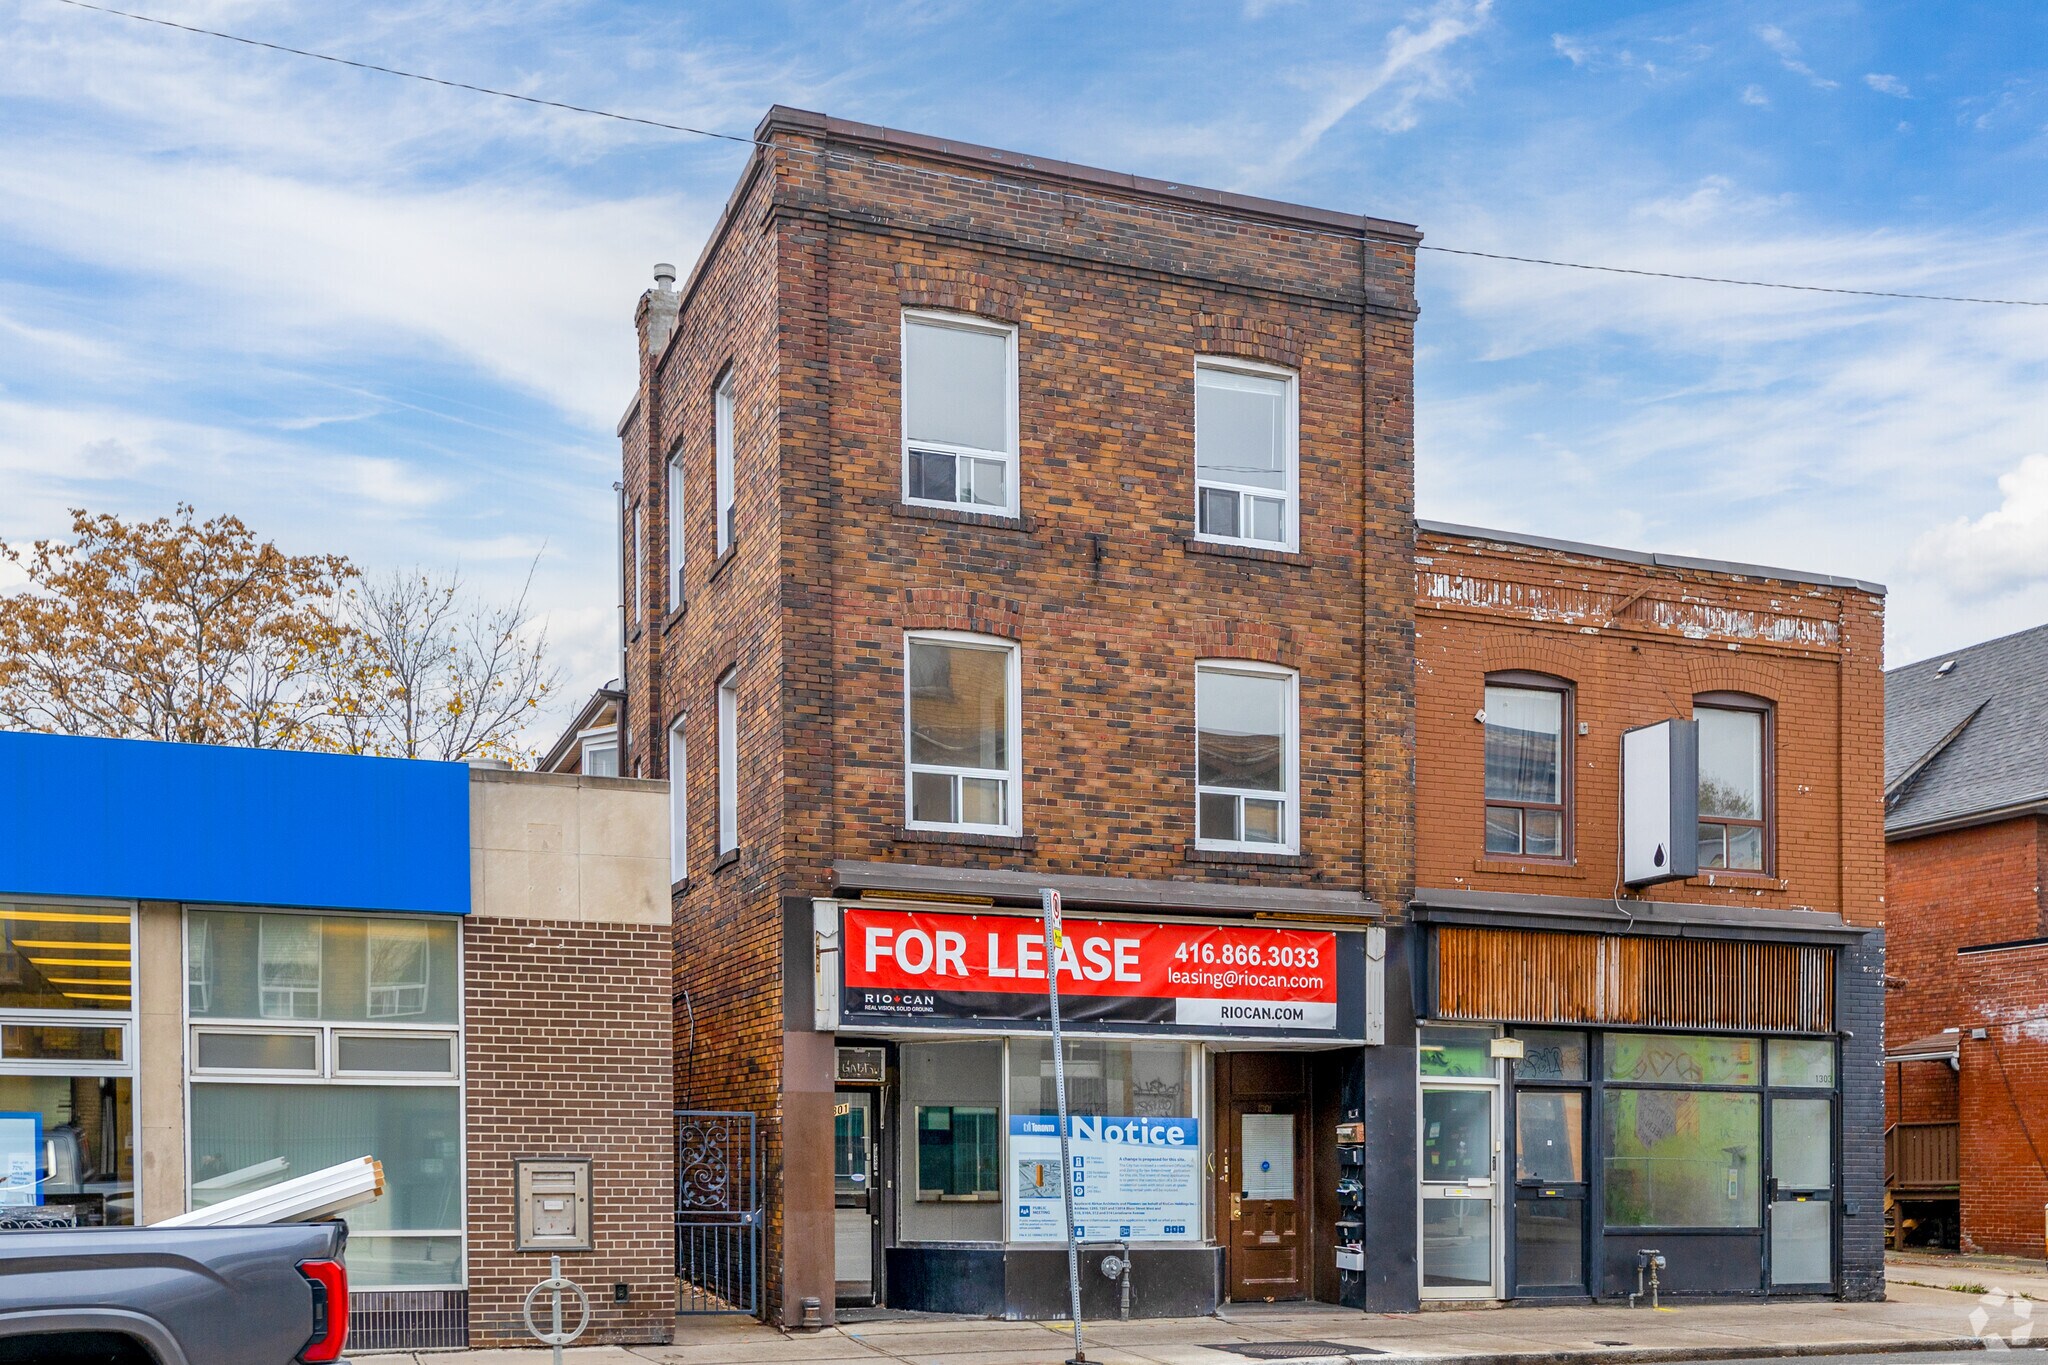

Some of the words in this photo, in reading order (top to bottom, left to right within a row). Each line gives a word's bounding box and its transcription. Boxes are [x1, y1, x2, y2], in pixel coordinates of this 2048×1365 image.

[865, 927, 969, 977] FOR
[988, 932, 1141, 983] LEASE
[1175, 942, 1319, 968] 416.866.3033
[1168, 967, 1323, 989] leasing@riocan.com
[1221, 1006, 1303, 1021] RIOCAN.COM
[1815, 1074, 1833, 1083] 1303
[1031, 1122, 1055, 1133] TORONTO
[1071, 1116, 1185, 1146] Notice
